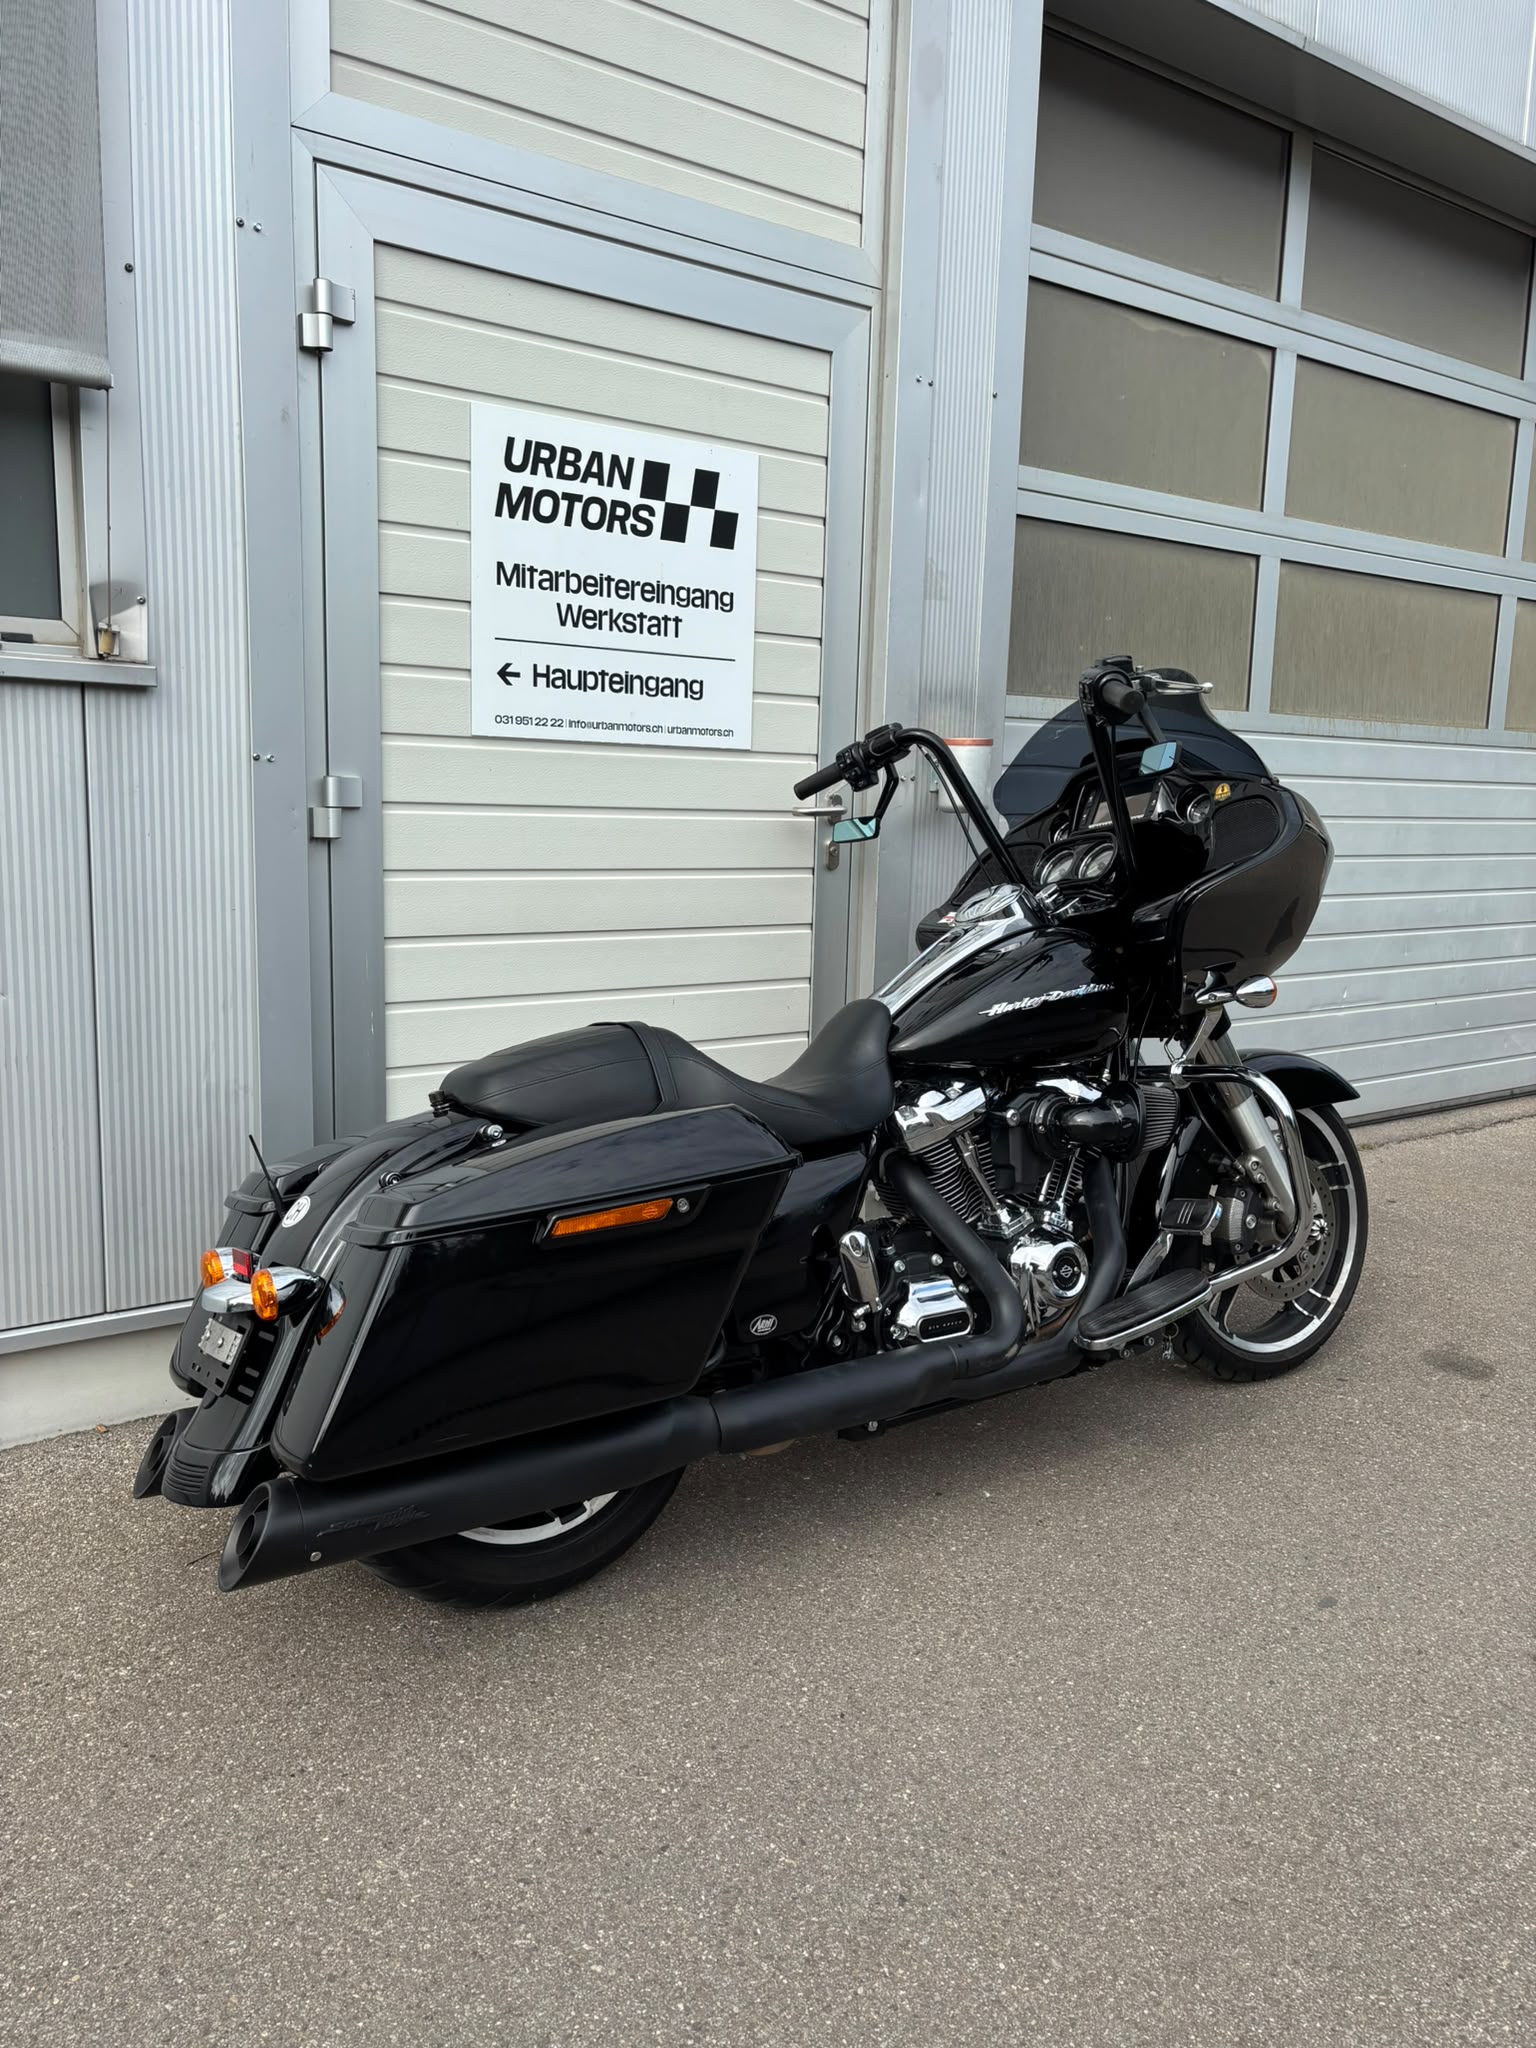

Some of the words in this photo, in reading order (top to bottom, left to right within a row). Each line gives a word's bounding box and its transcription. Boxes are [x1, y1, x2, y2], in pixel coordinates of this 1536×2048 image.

[503, 435, 635, 491] URBAN
[494, 481, 656, 538] MOTORS
[496, 560, 734, 613] Mitarbeitereingang
[556, 602, 683, 639] Werkstatt
[532, 663, 704, 701] Haupteingang
[667, 725, 734, 737] urbanmotors.ch
